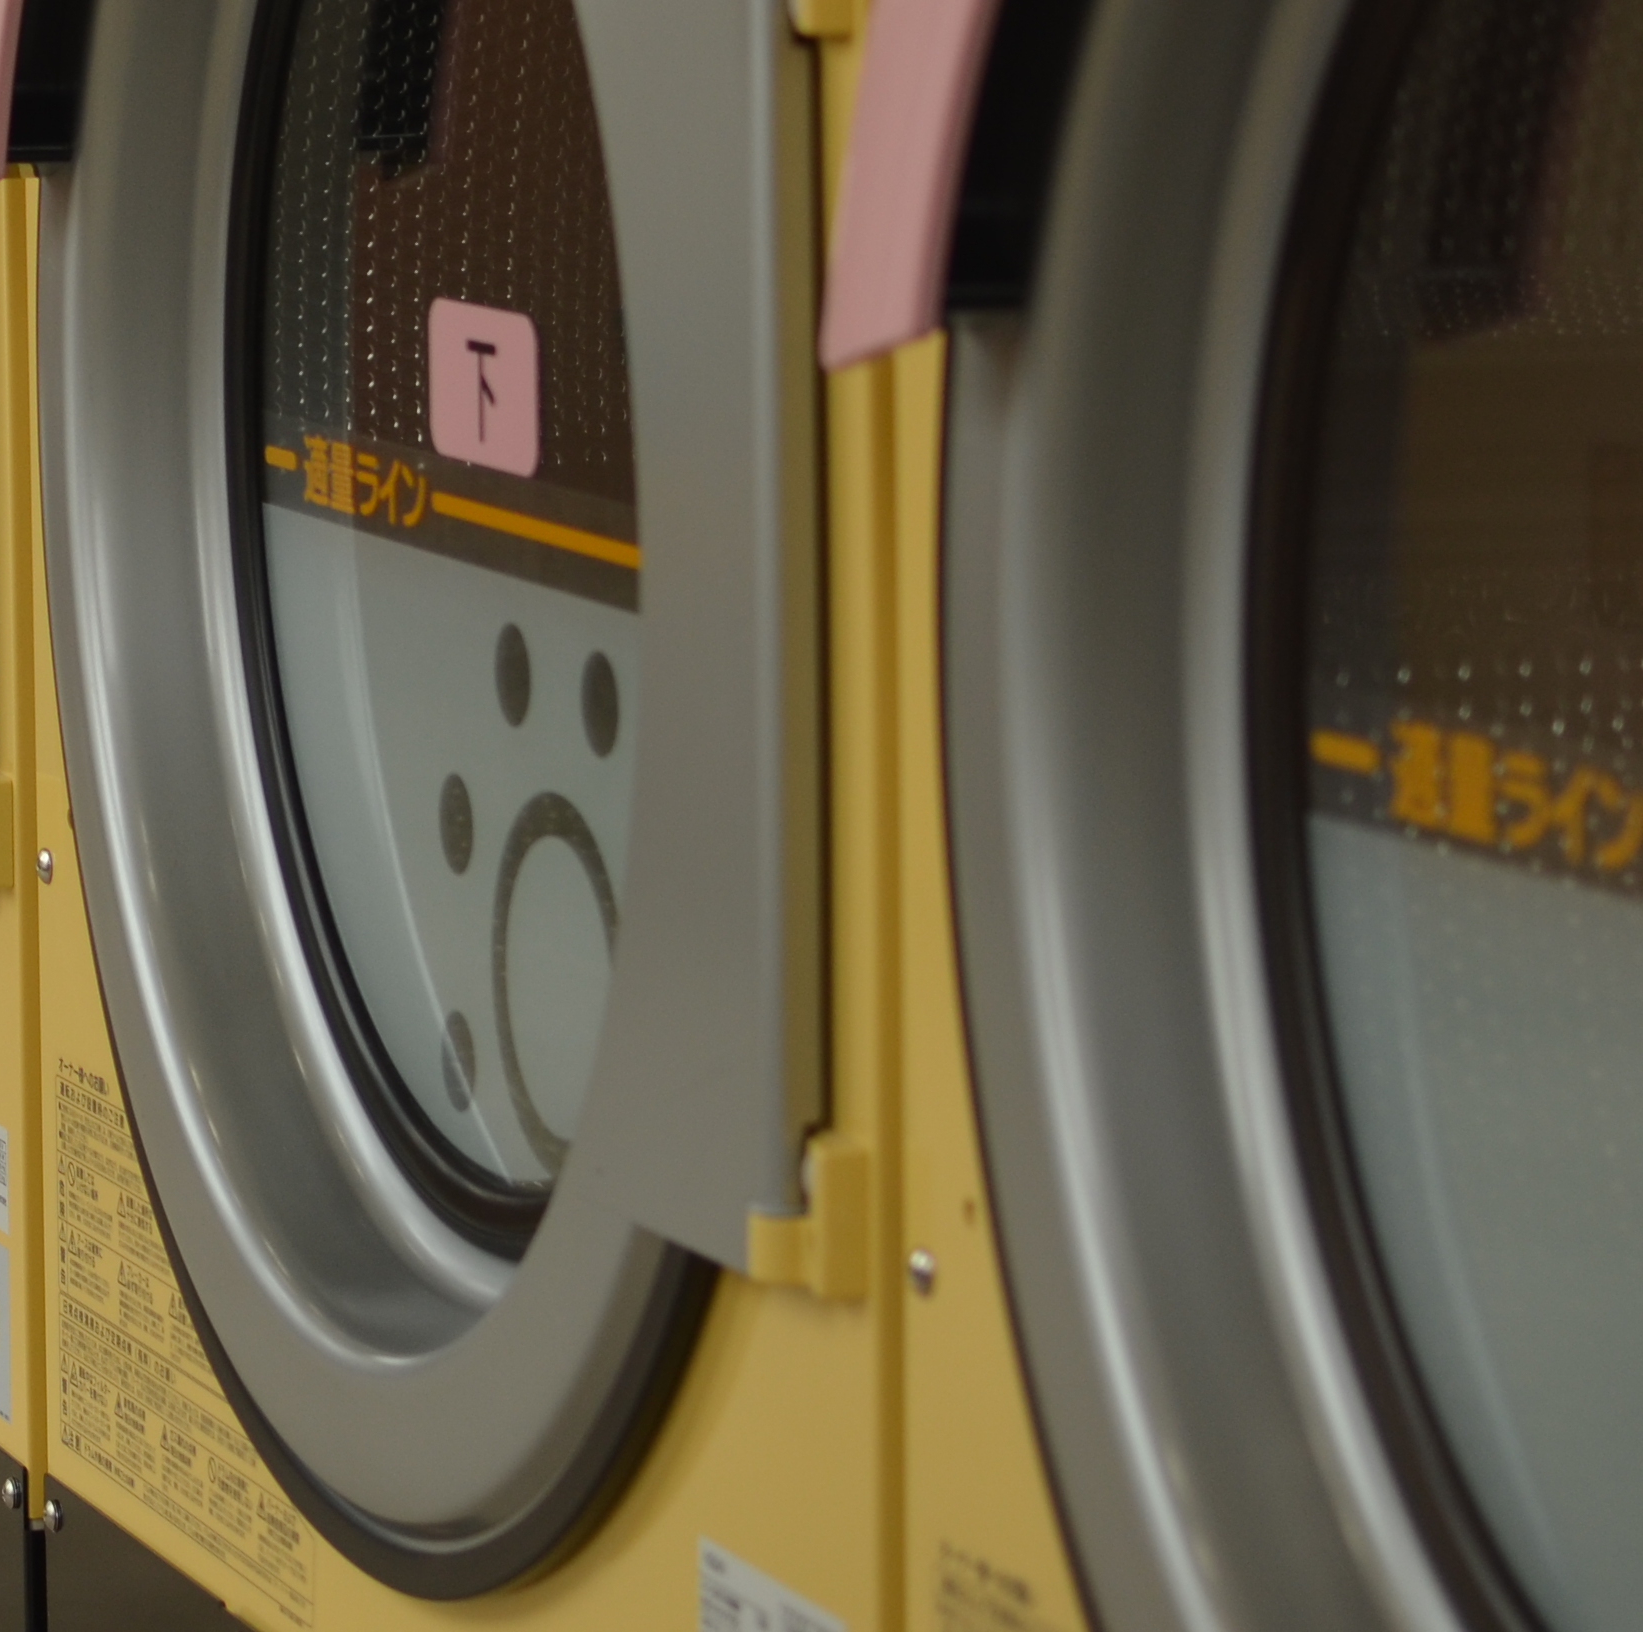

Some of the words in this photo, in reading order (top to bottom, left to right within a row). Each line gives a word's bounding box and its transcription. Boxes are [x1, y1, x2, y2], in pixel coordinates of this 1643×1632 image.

[466, 339, 496, 444] 下
[303, 433, 426, 528] 適量ライン
